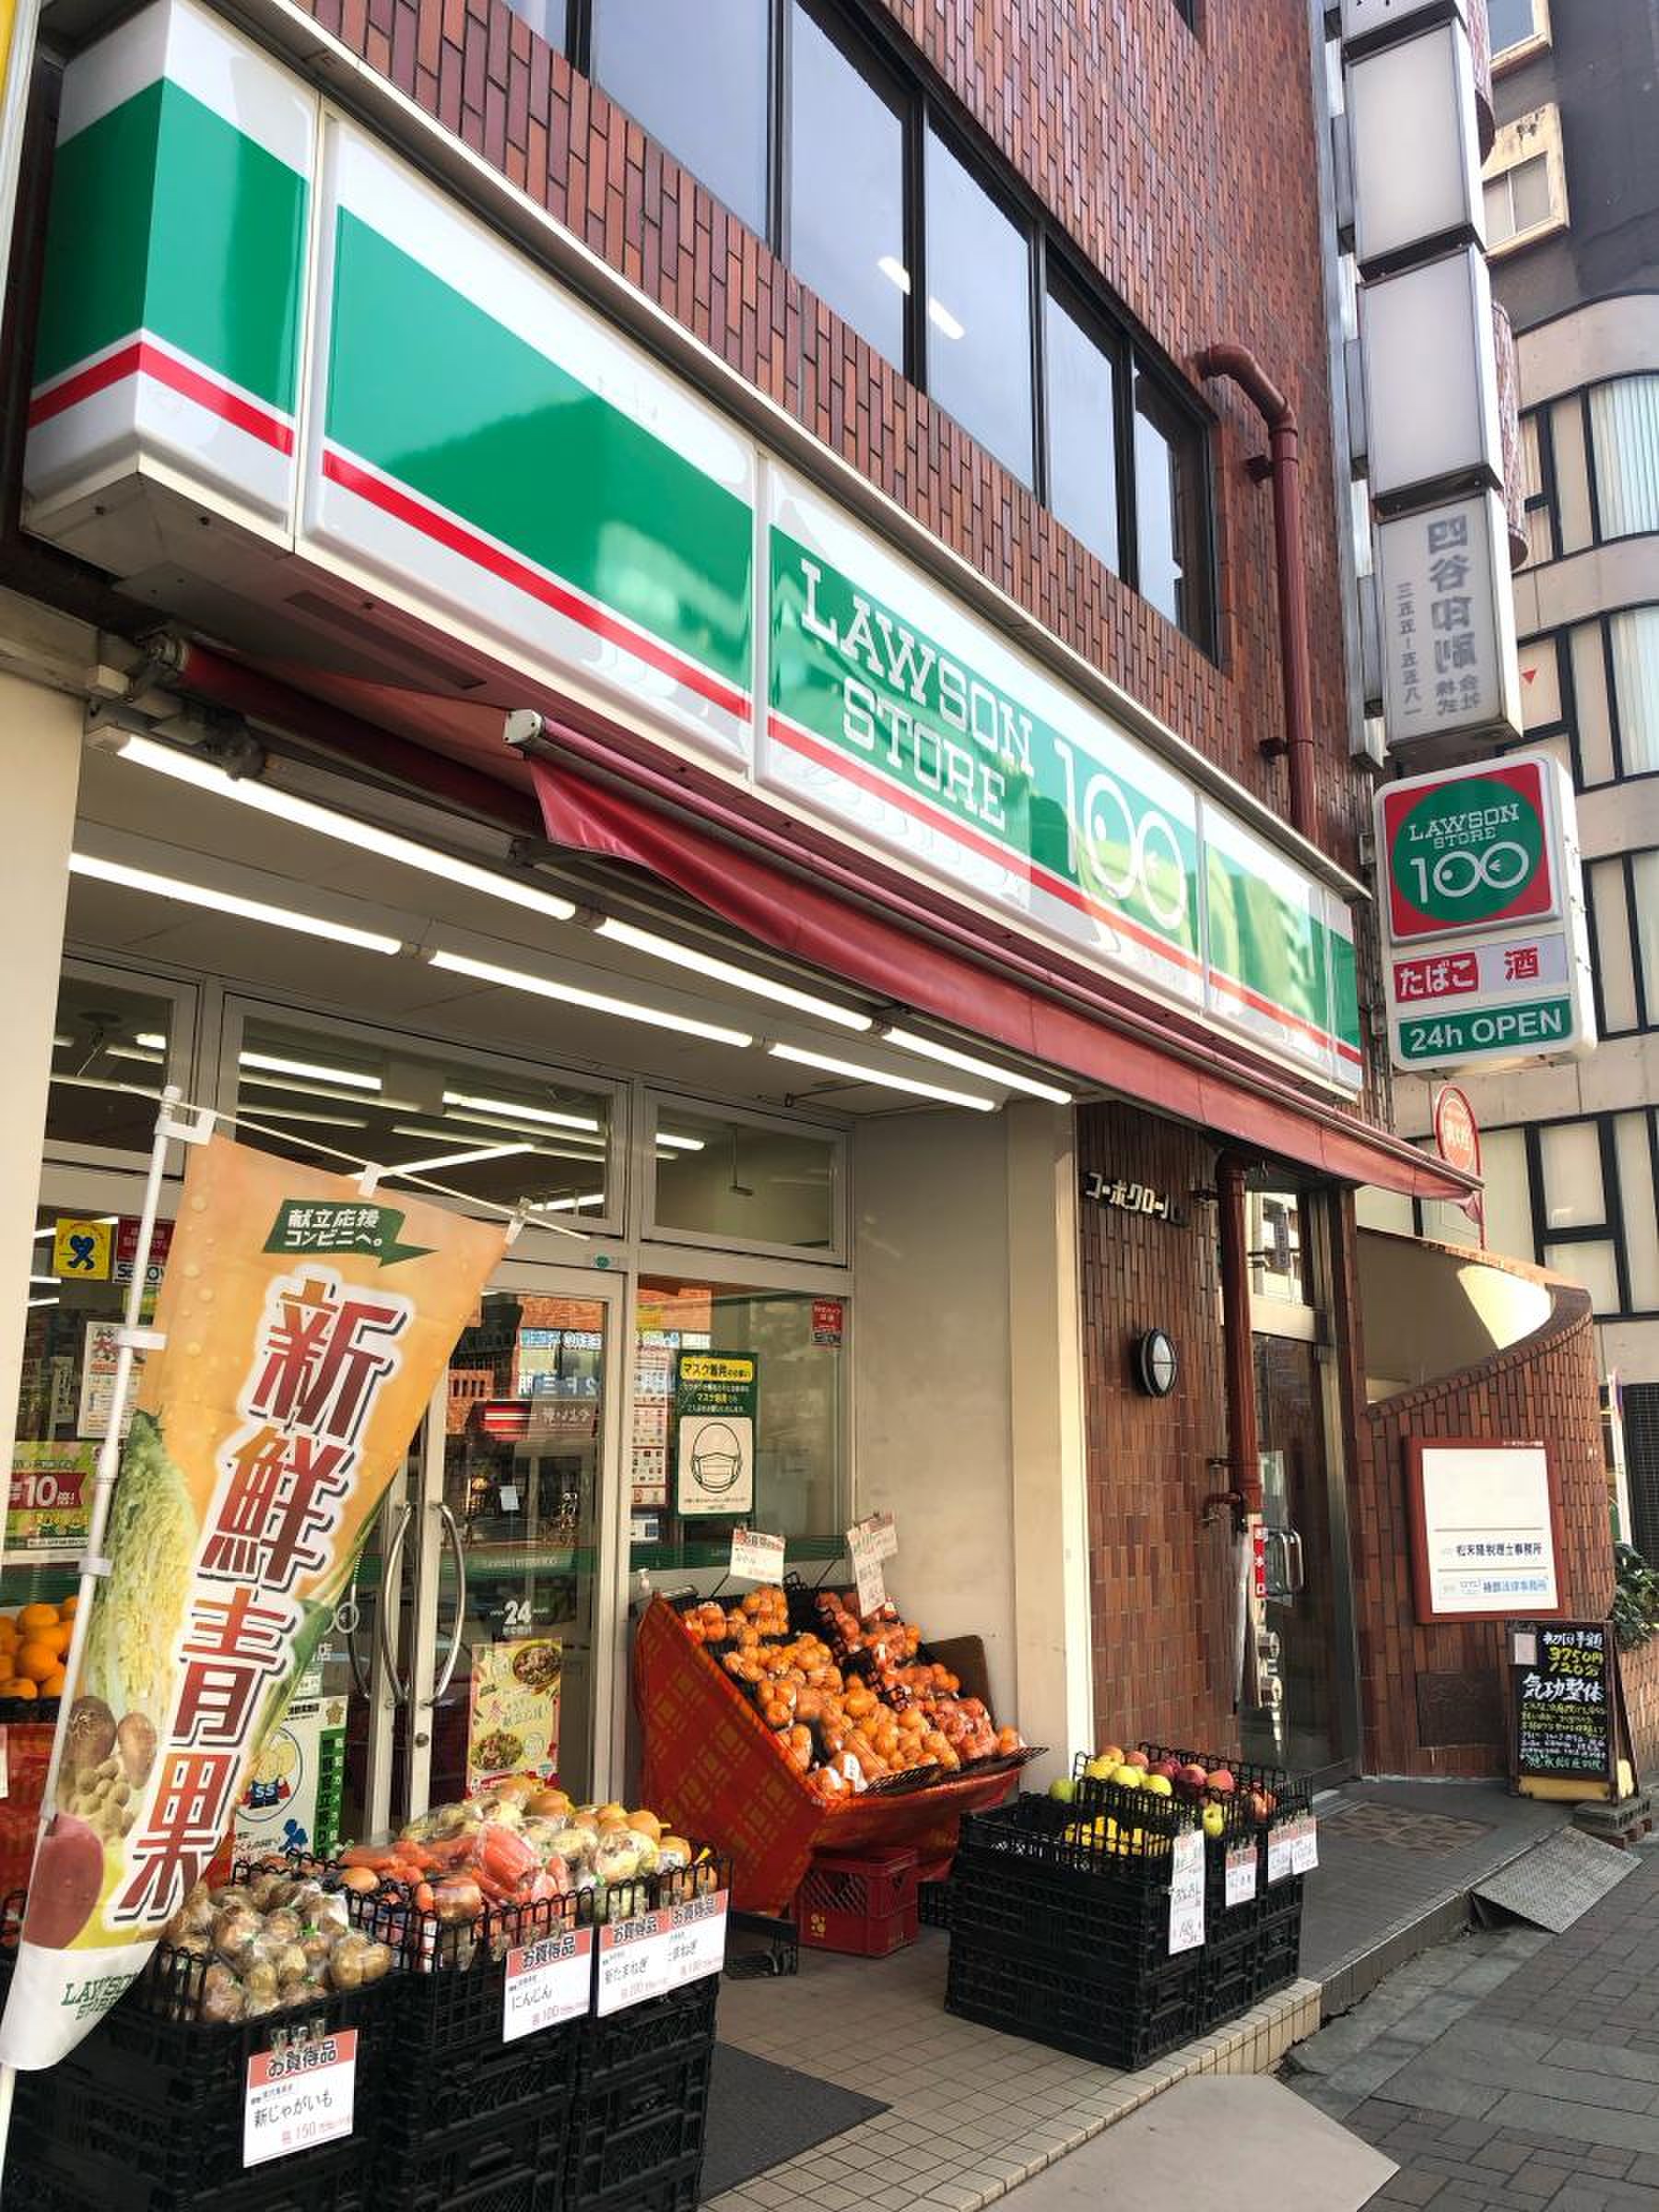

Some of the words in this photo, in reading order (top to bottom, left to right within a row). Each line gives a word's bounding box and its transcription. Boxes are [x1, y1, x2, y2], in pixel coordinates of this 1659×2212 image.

[800, 559, 1035, 776] LAWSON
[843, 677, 1006, 832] STORE
[1053, 737, 1188, 930] 100
[1408, 803, 1521, 842] LAWSON
[1433, 826, 1497, 850] STORE
[1410, 841, 1530, 904] 100
[1399, 958, 1476, 996] たばこ
[1504, 946, 1541, 982] 酒
[1410, 1025, 1464, 1053] 24h
[1473, 1007, 1564, 1045] OPEN
[288, 1208, 380, 1229] 献立応援
[284, 1229, 383, 1247] コンビニへ。
[115, 1277, 404, 1922] 新鮮青果
[504, 1600, 532, 1625] 24
[1522, 1672, 1605, 1703] 気功整体
[254, 1783, 276, 1798] SS
[511, 1983, 552, 2011] にんじん
[253, 2088, 334, 2130] 新じゃがいも
